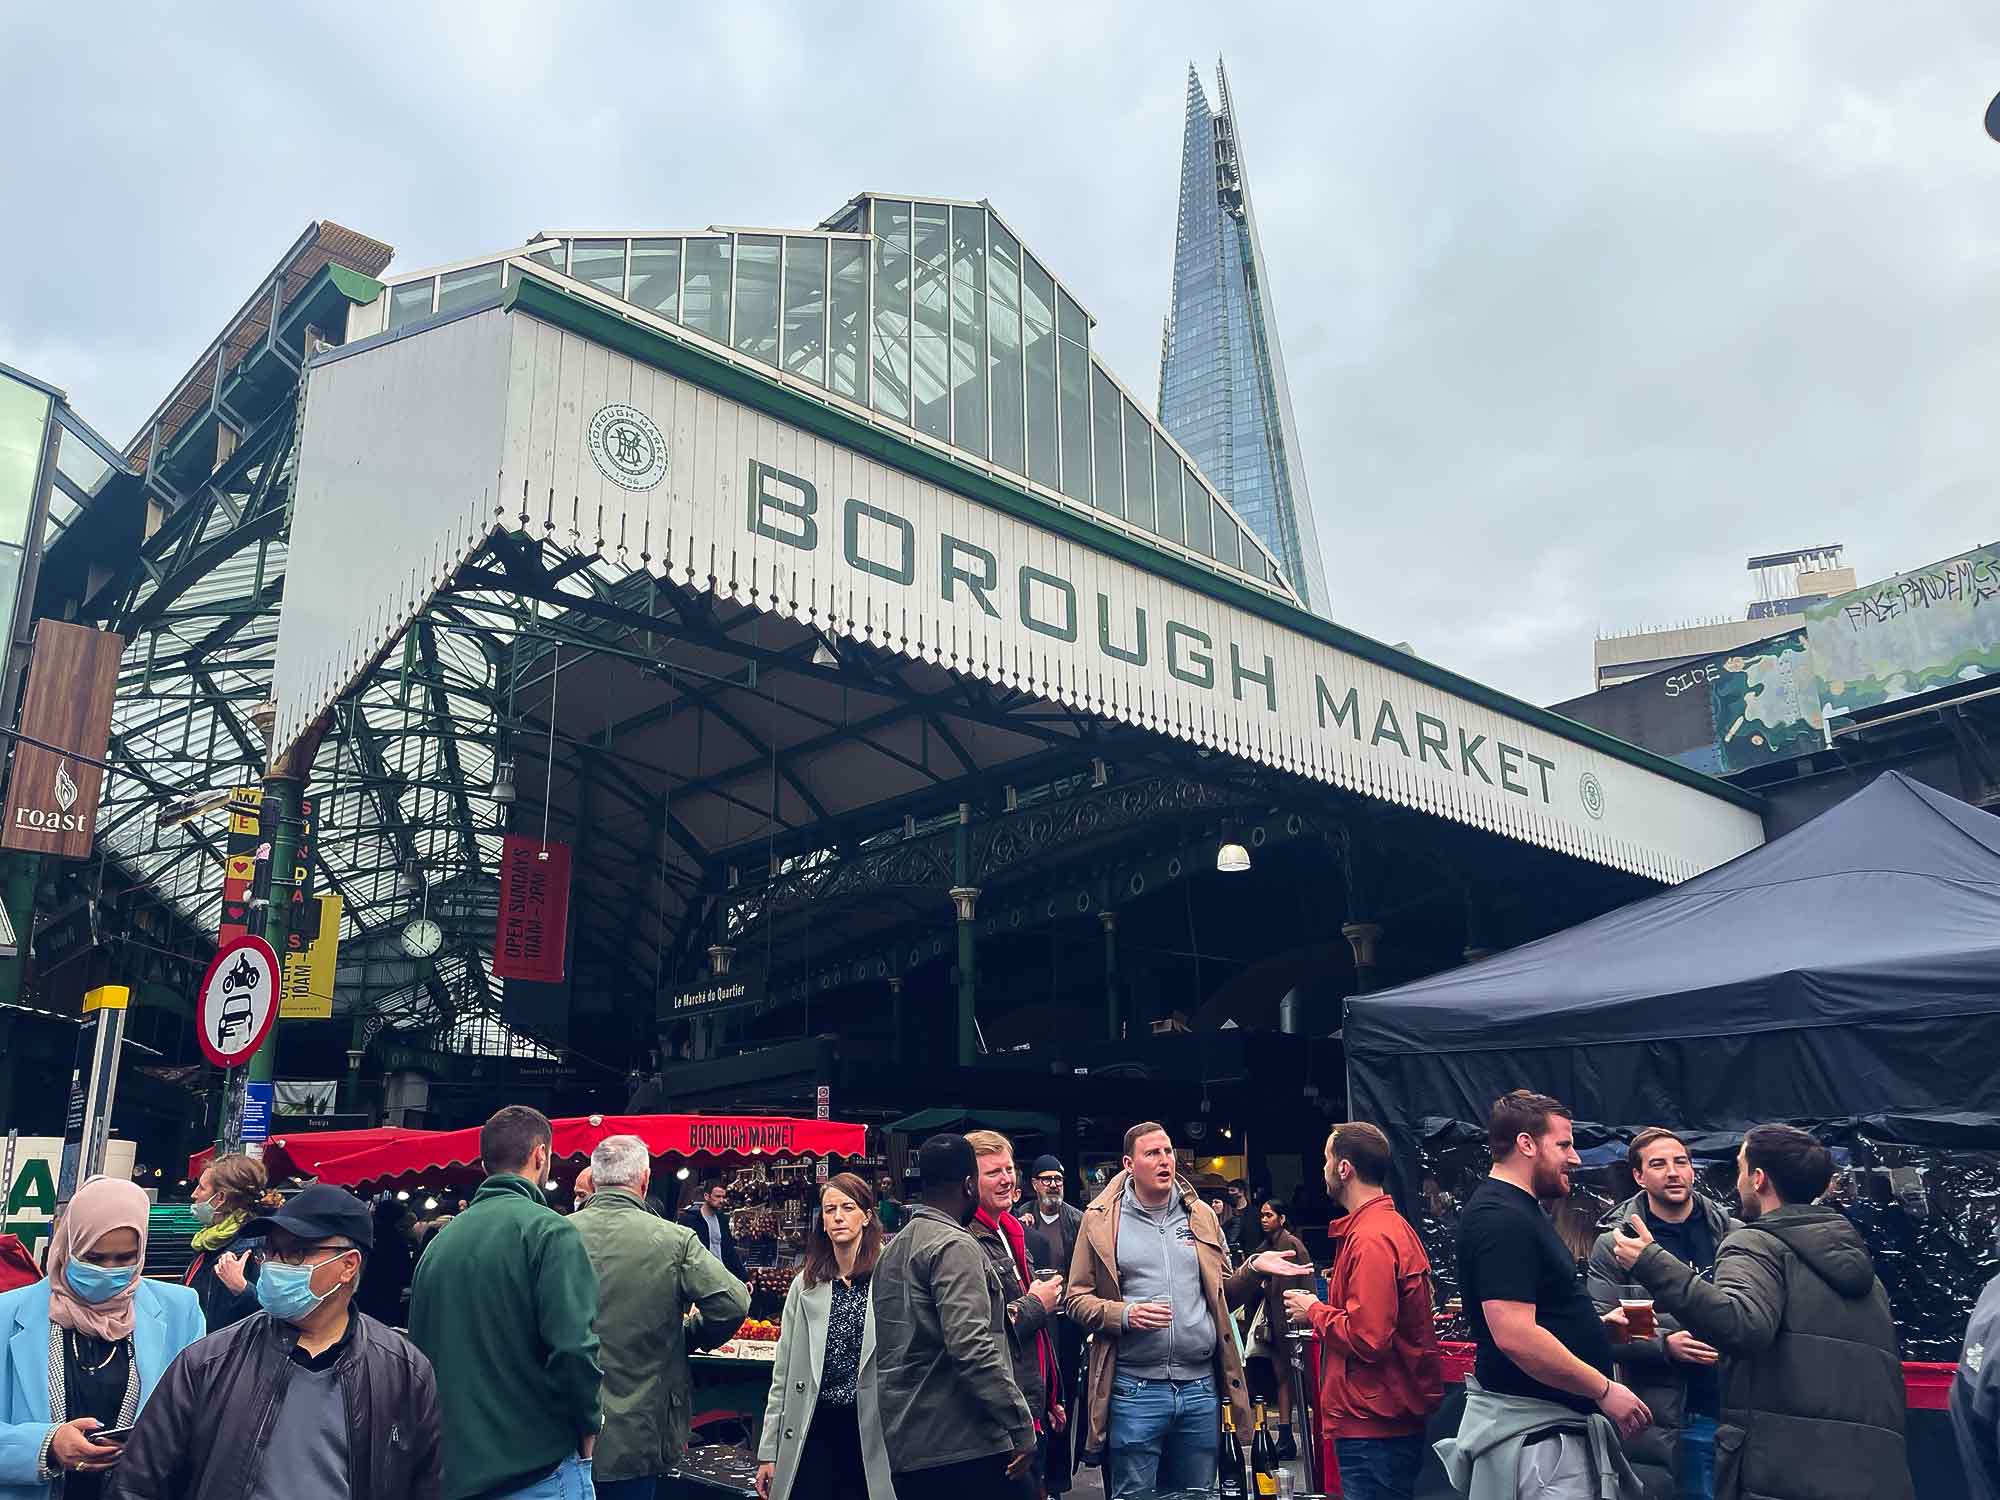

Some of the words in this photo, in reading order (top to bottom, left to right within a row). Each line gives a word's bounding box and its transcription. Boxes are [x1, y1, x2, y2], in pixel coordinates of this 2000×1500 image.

[747, 457, 1278, 713] BOROUGH
[1314, 674, 1556, 804] MARKET
[1664, 663, 1721, 697] SIDE
[15, 807, 87, 832] roast
[508, 847, 530, 913] SUNDAYS
[504, 918, 524, 959] OPEN
[674, 995, 682, 1008] Le
[683, 990, 706, 1007] Marché
[717, 983, 745, 1002] Quartier
[689, 1124, 746, 1149] BOROUGH
[749, 1125, 795, 1149] MARKET
